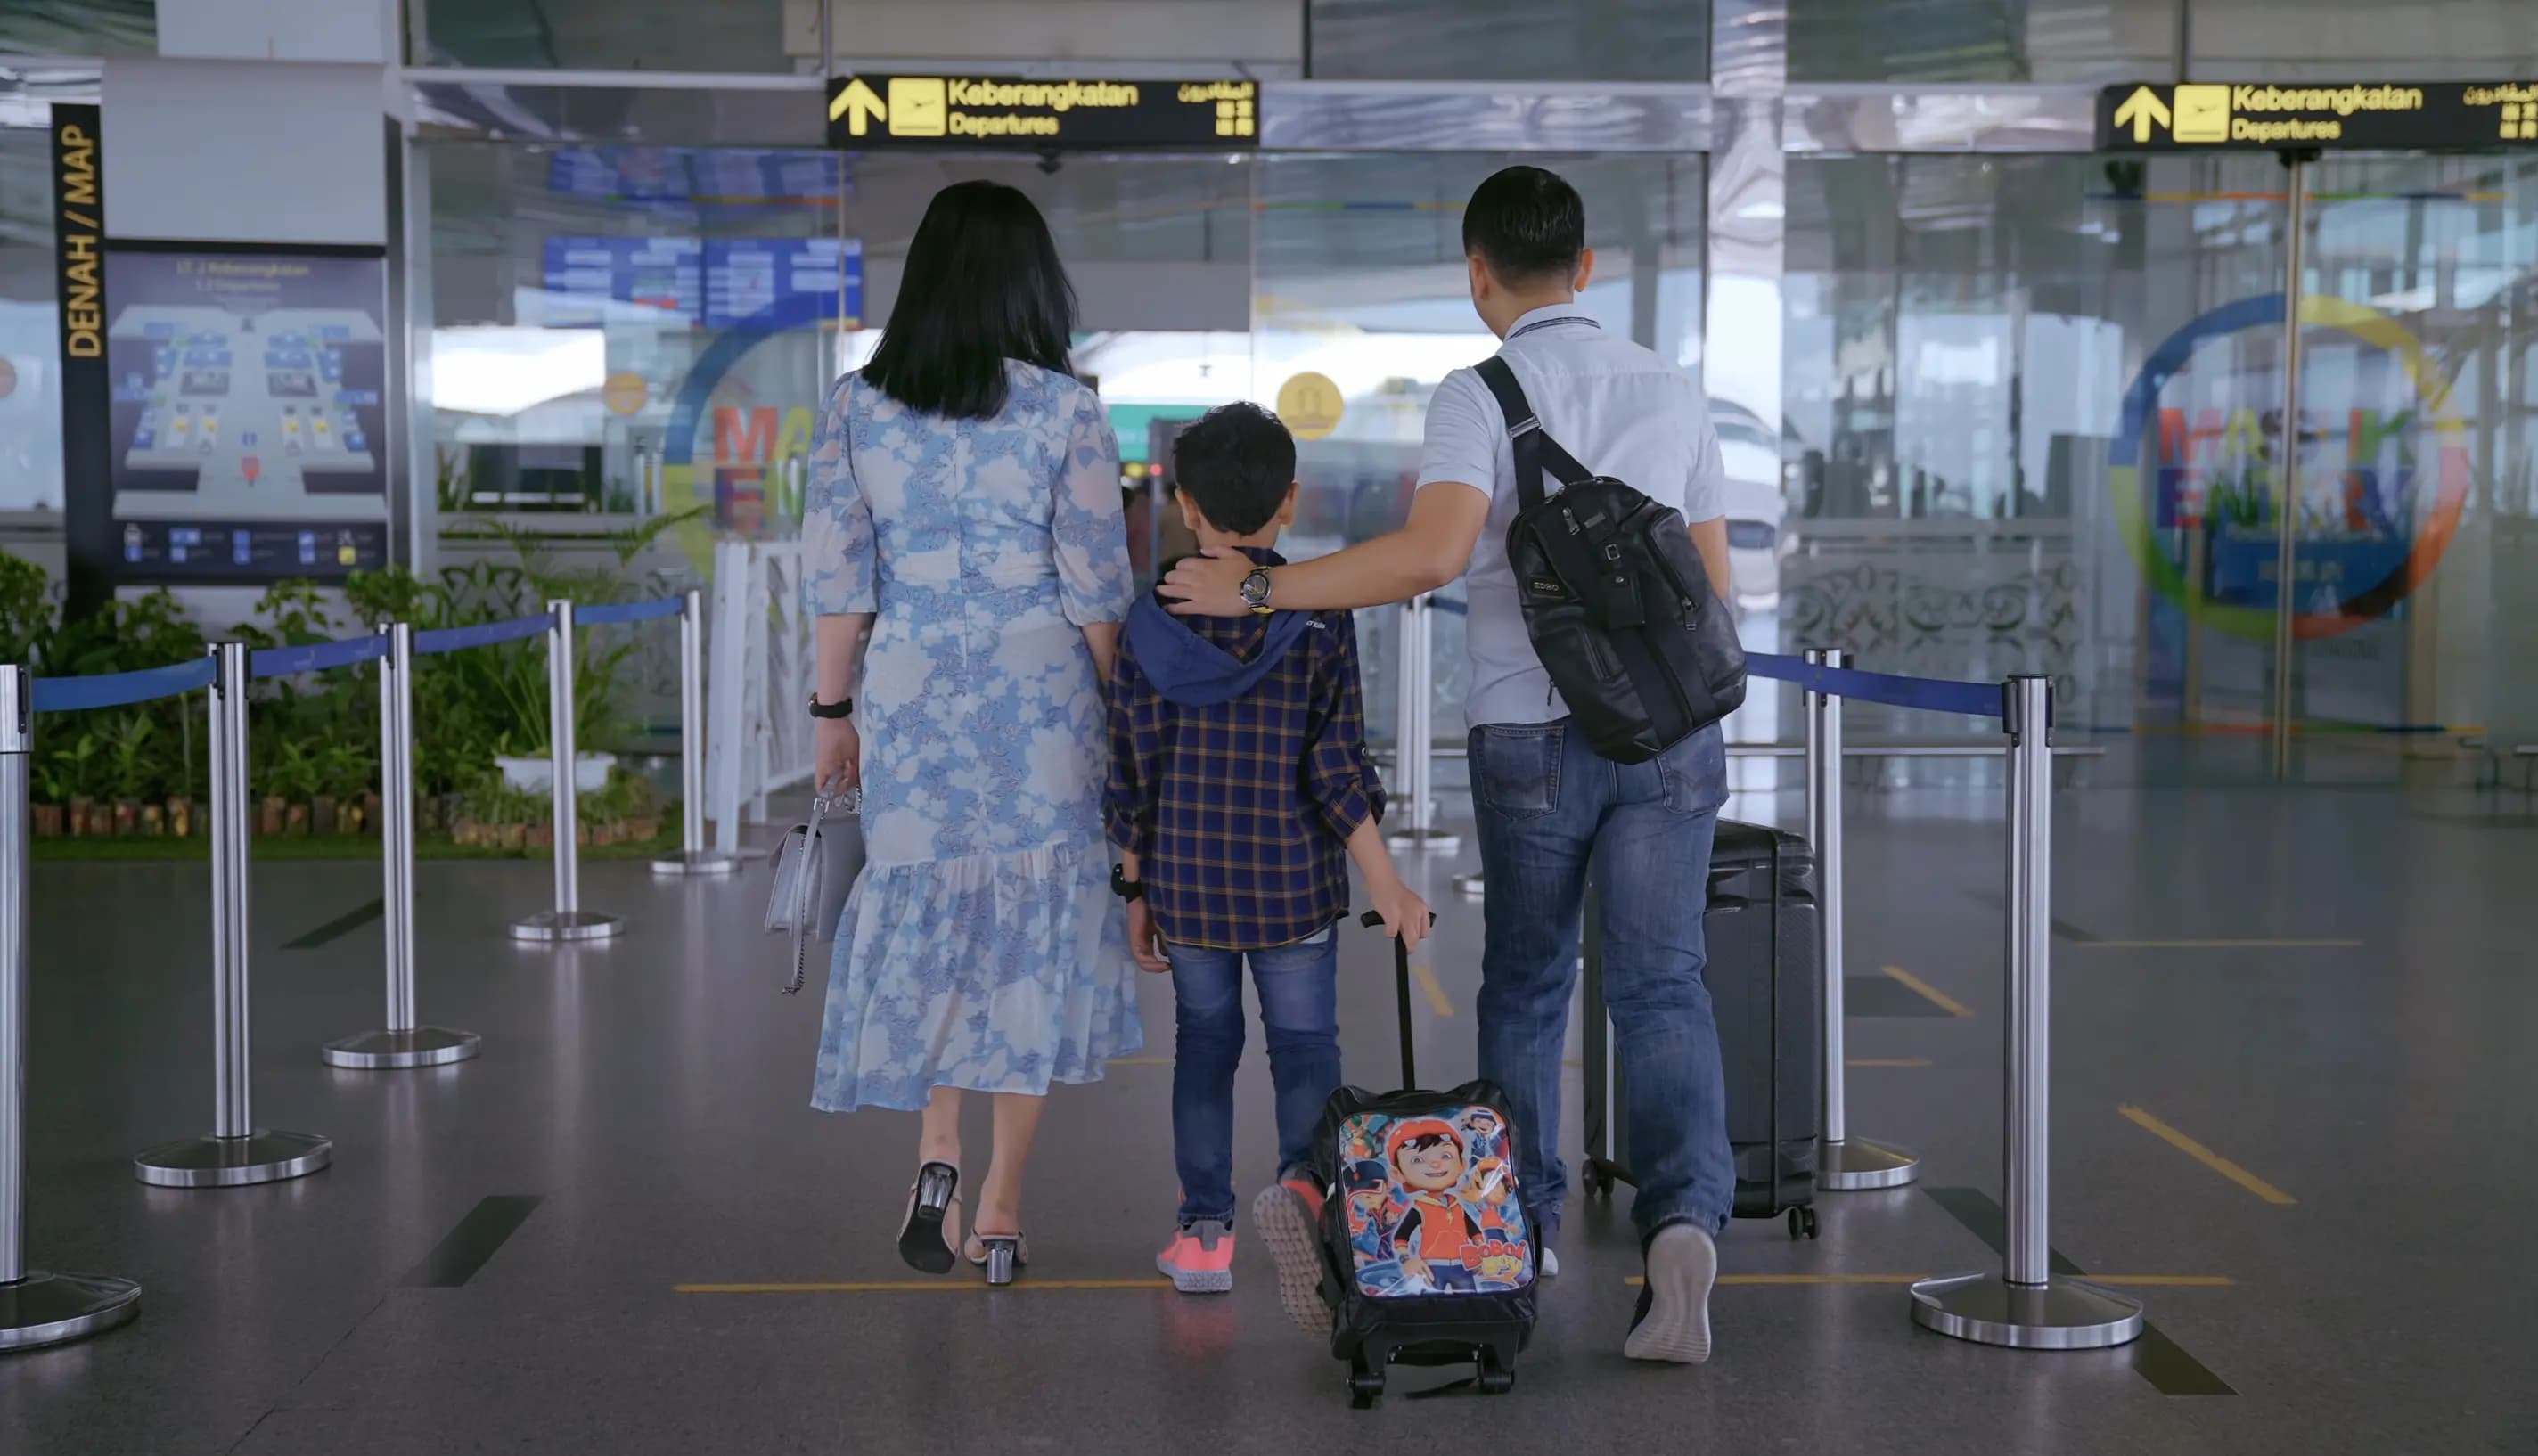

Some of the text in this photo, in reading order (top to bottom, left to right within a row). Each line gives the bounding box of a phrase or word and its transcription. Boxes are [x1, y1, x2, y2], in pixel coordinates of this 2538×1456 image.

[948, 79, 1140, 112] Keberangkatan
[2232, 85, 2424, 116] Keberangkatan
[949, 112, 1060, 139] Departures
[2231, 119, 2342, 144] Departures
[61, 124, 102, 357] DENAH / MAP
